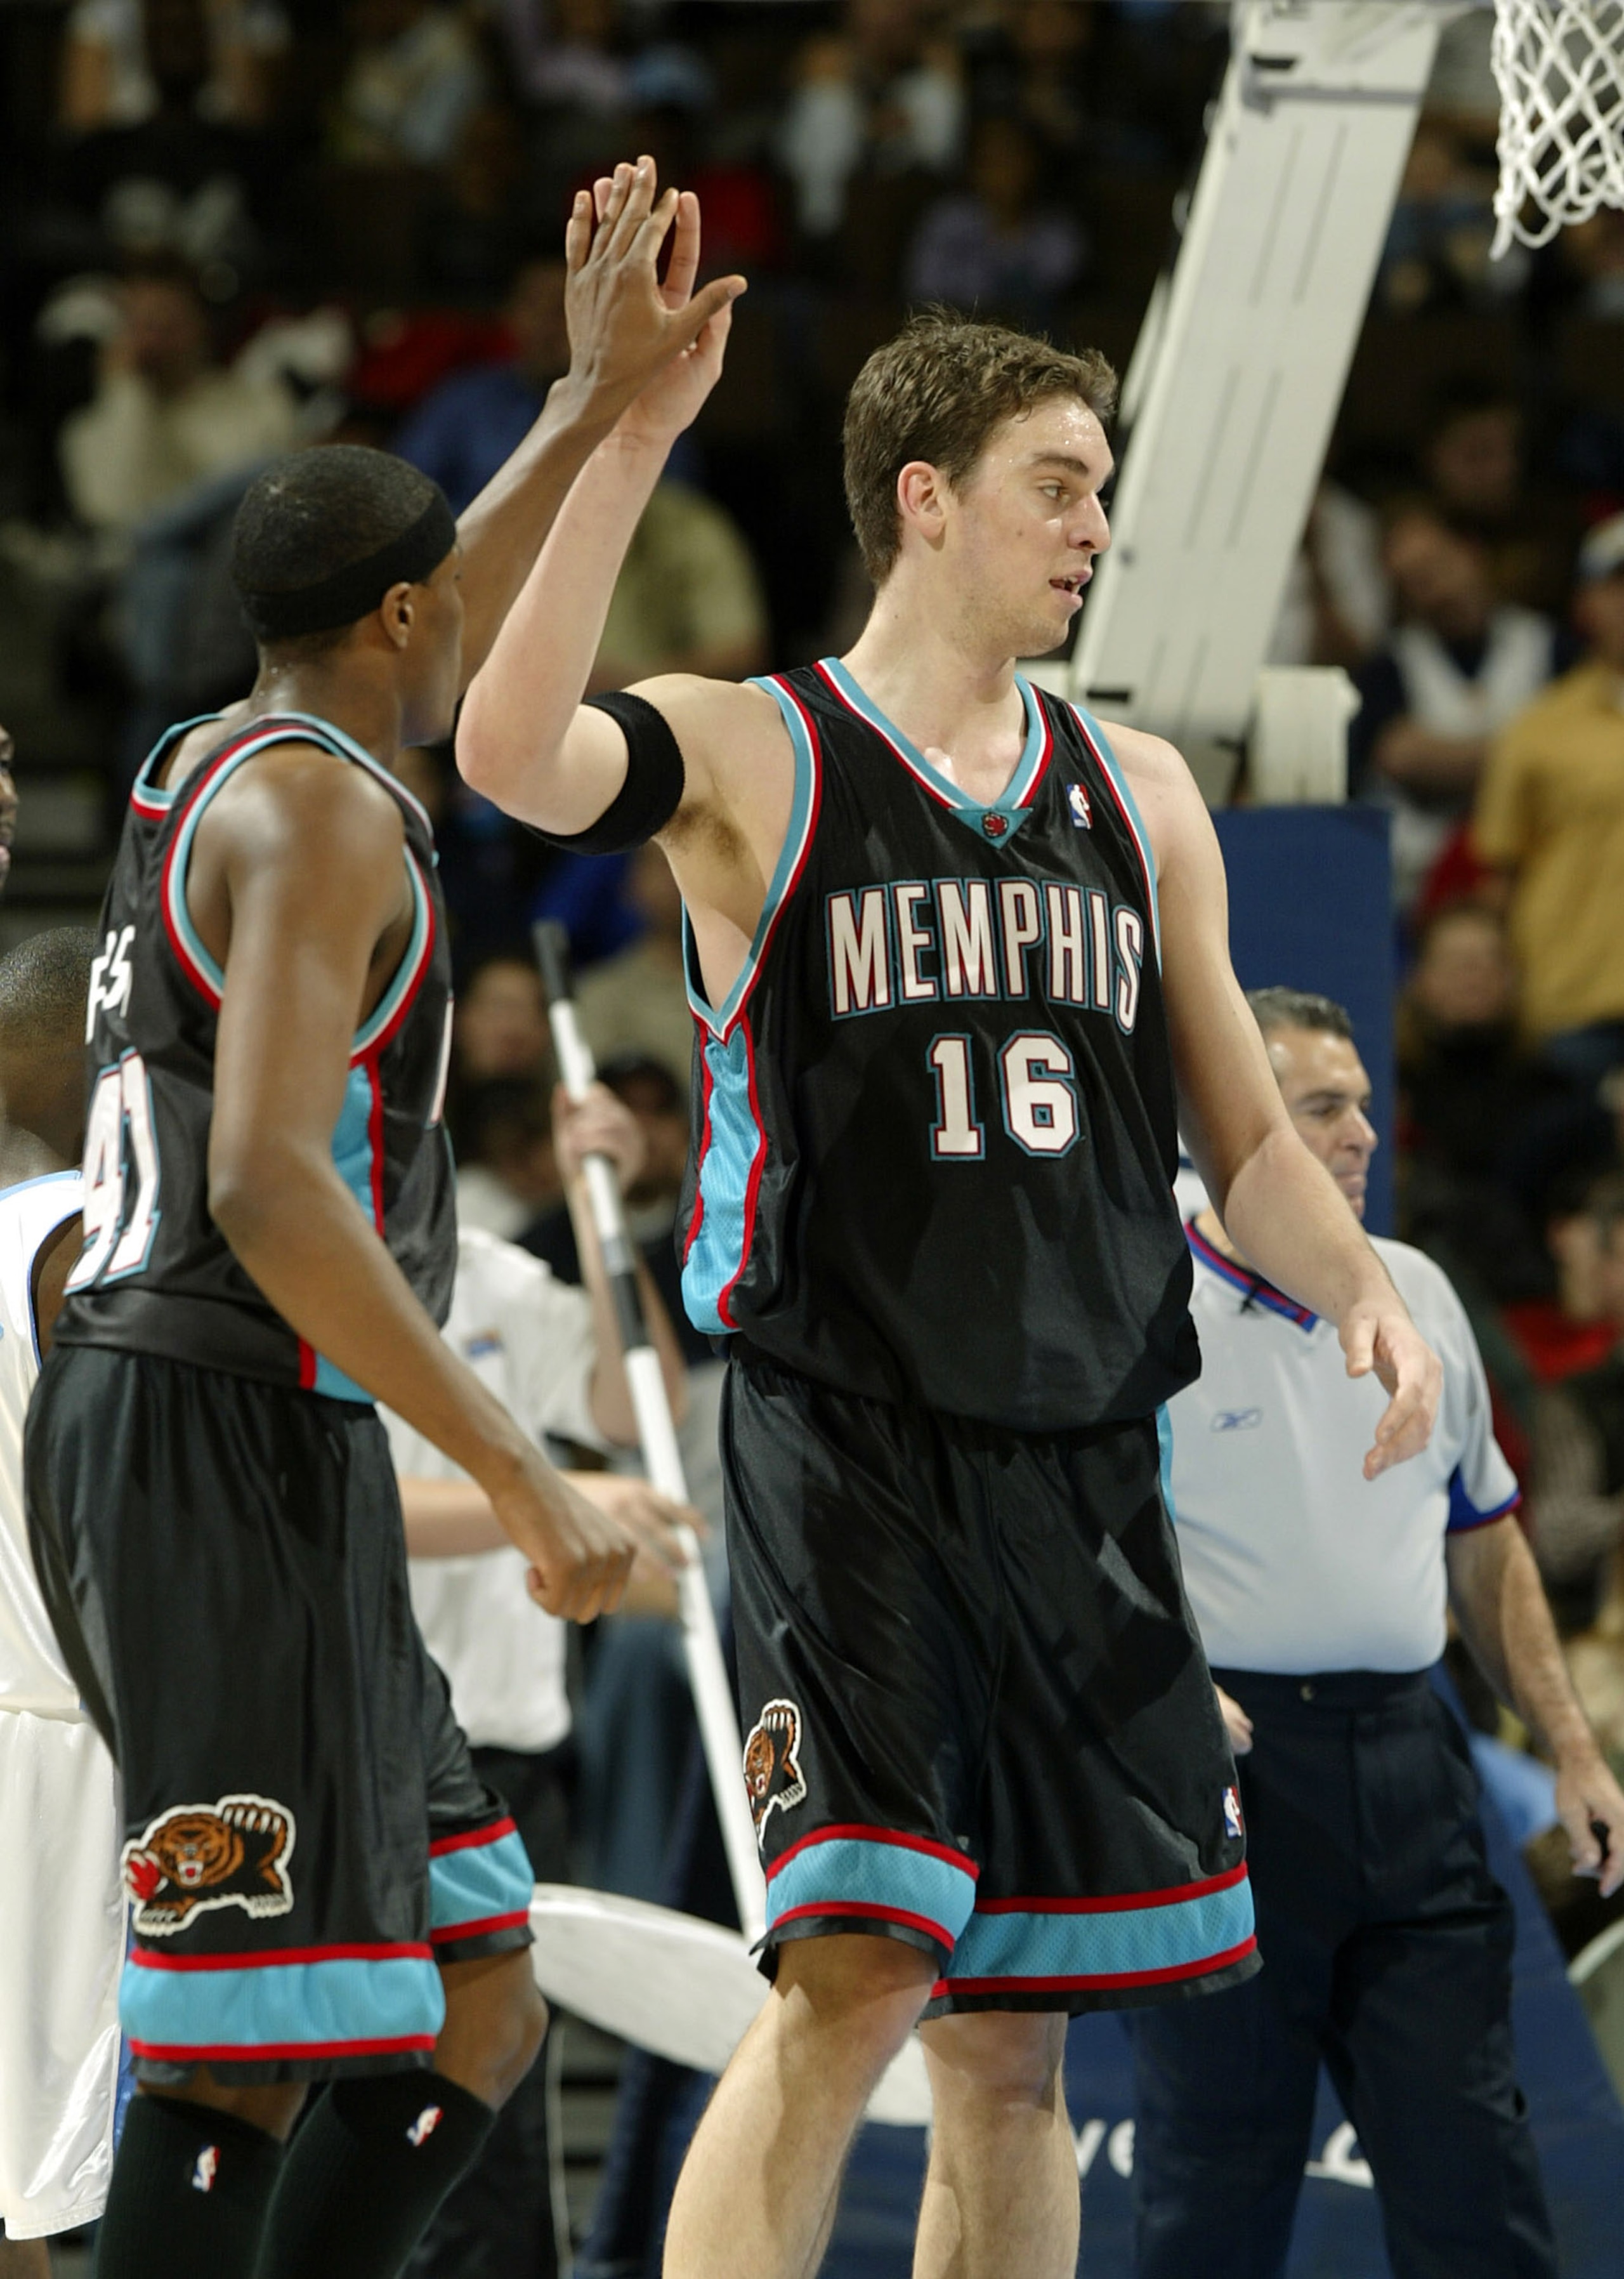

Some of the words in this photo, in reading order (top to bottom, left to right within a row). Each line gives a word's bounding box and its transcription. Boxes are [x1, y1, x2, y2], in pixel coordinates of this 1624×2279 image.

[826, 877, 1143, 1035] MEMPHIS
[63, 1047, 162, 1296] 41
[925, 1029, 1080, 1160] 16
